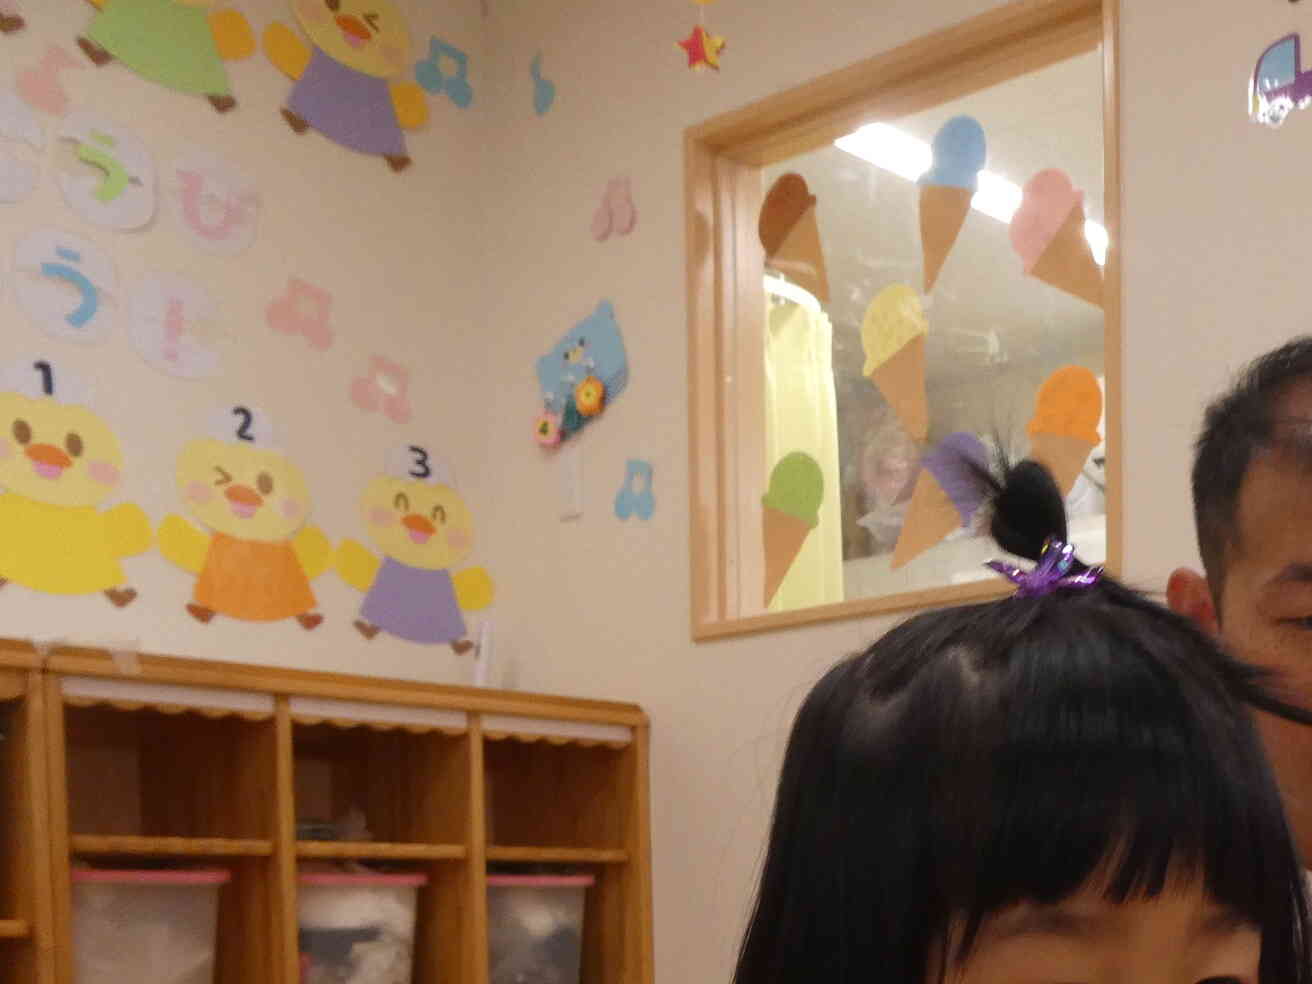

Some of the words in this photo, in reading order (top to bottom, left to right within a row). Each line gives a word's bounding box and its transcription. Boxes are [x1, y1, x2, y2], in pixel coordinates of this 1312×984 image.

[33, 361, 54, 396] 1
[233, 406, 255, 442] 2
[409, 445, 431, 479] 3
